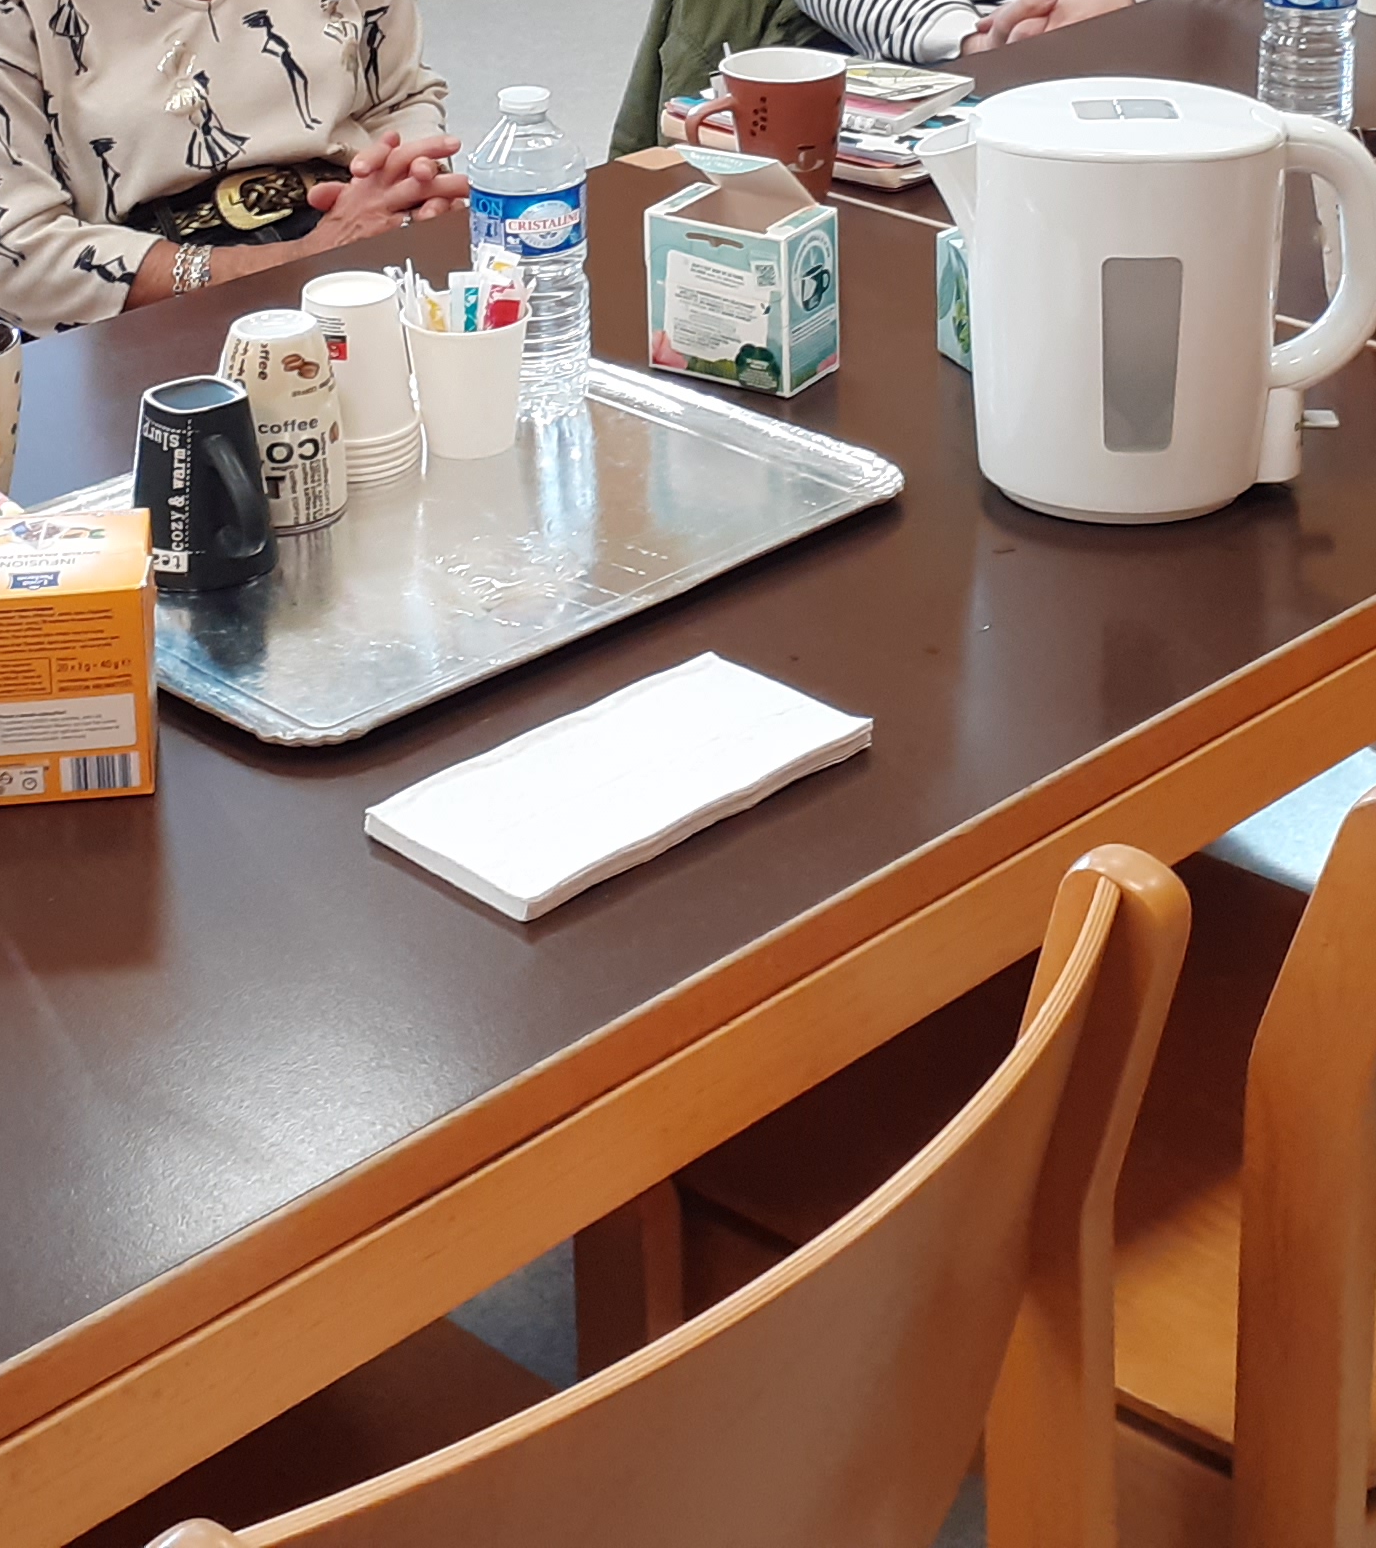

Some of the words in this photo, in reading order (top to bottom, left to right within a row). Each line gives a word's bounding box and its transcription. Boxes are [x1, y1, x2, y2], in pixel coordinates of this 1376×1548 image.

[142, 419, 181, 452] slurp
[258, 417, 319, 435] coffee
[172, 448, 187, 490] warm
[167, 495, 187, 508] &
[171, 509, 187, 552] cozy
[0, 558, 76, 569] INFUSION
